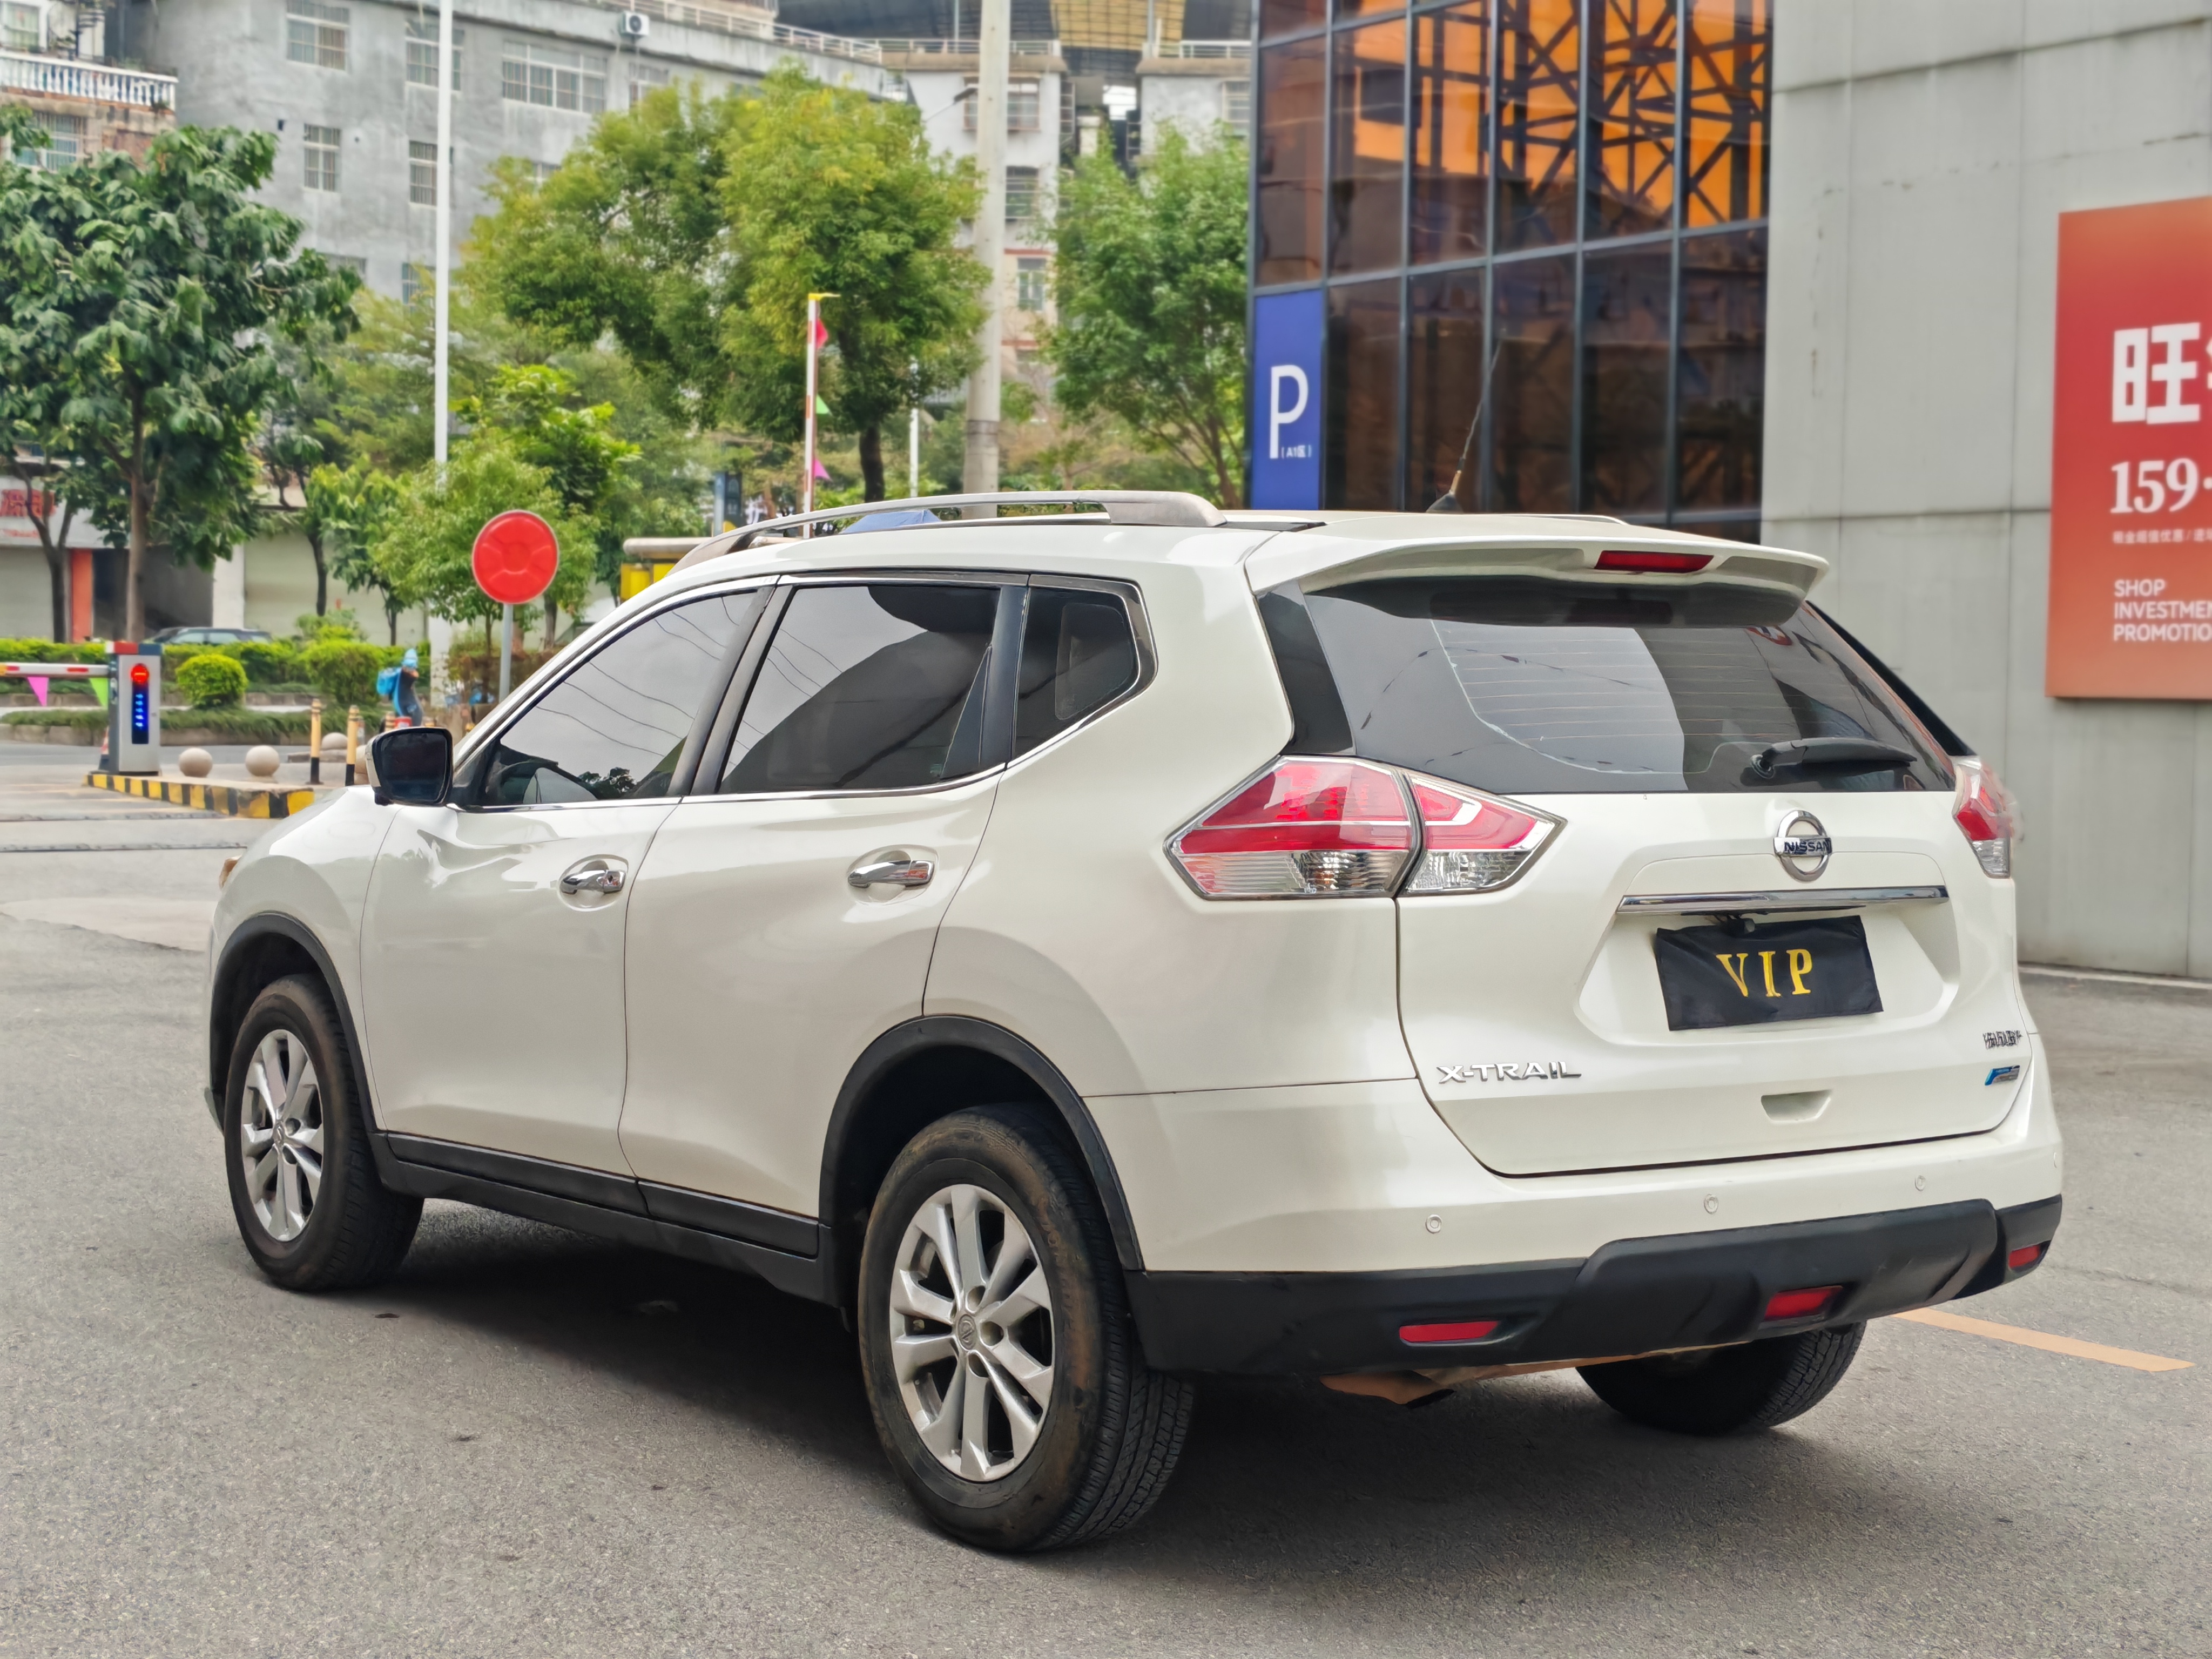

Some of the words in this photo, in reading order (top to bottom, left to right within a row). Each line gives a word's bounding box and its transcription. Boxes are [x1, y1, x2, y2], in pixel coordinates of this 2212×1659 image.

[2110, 322, 2212, 424] 旺
[1270, 365, 1309, 459] P
[2114, 579, 2166, 597] SHOP
[1784, 839, 1830, 853] NISSAN
[1716, 949, 1812, 997] VIP
[1436, 1061, 1582, 1084] X-TRAIL
